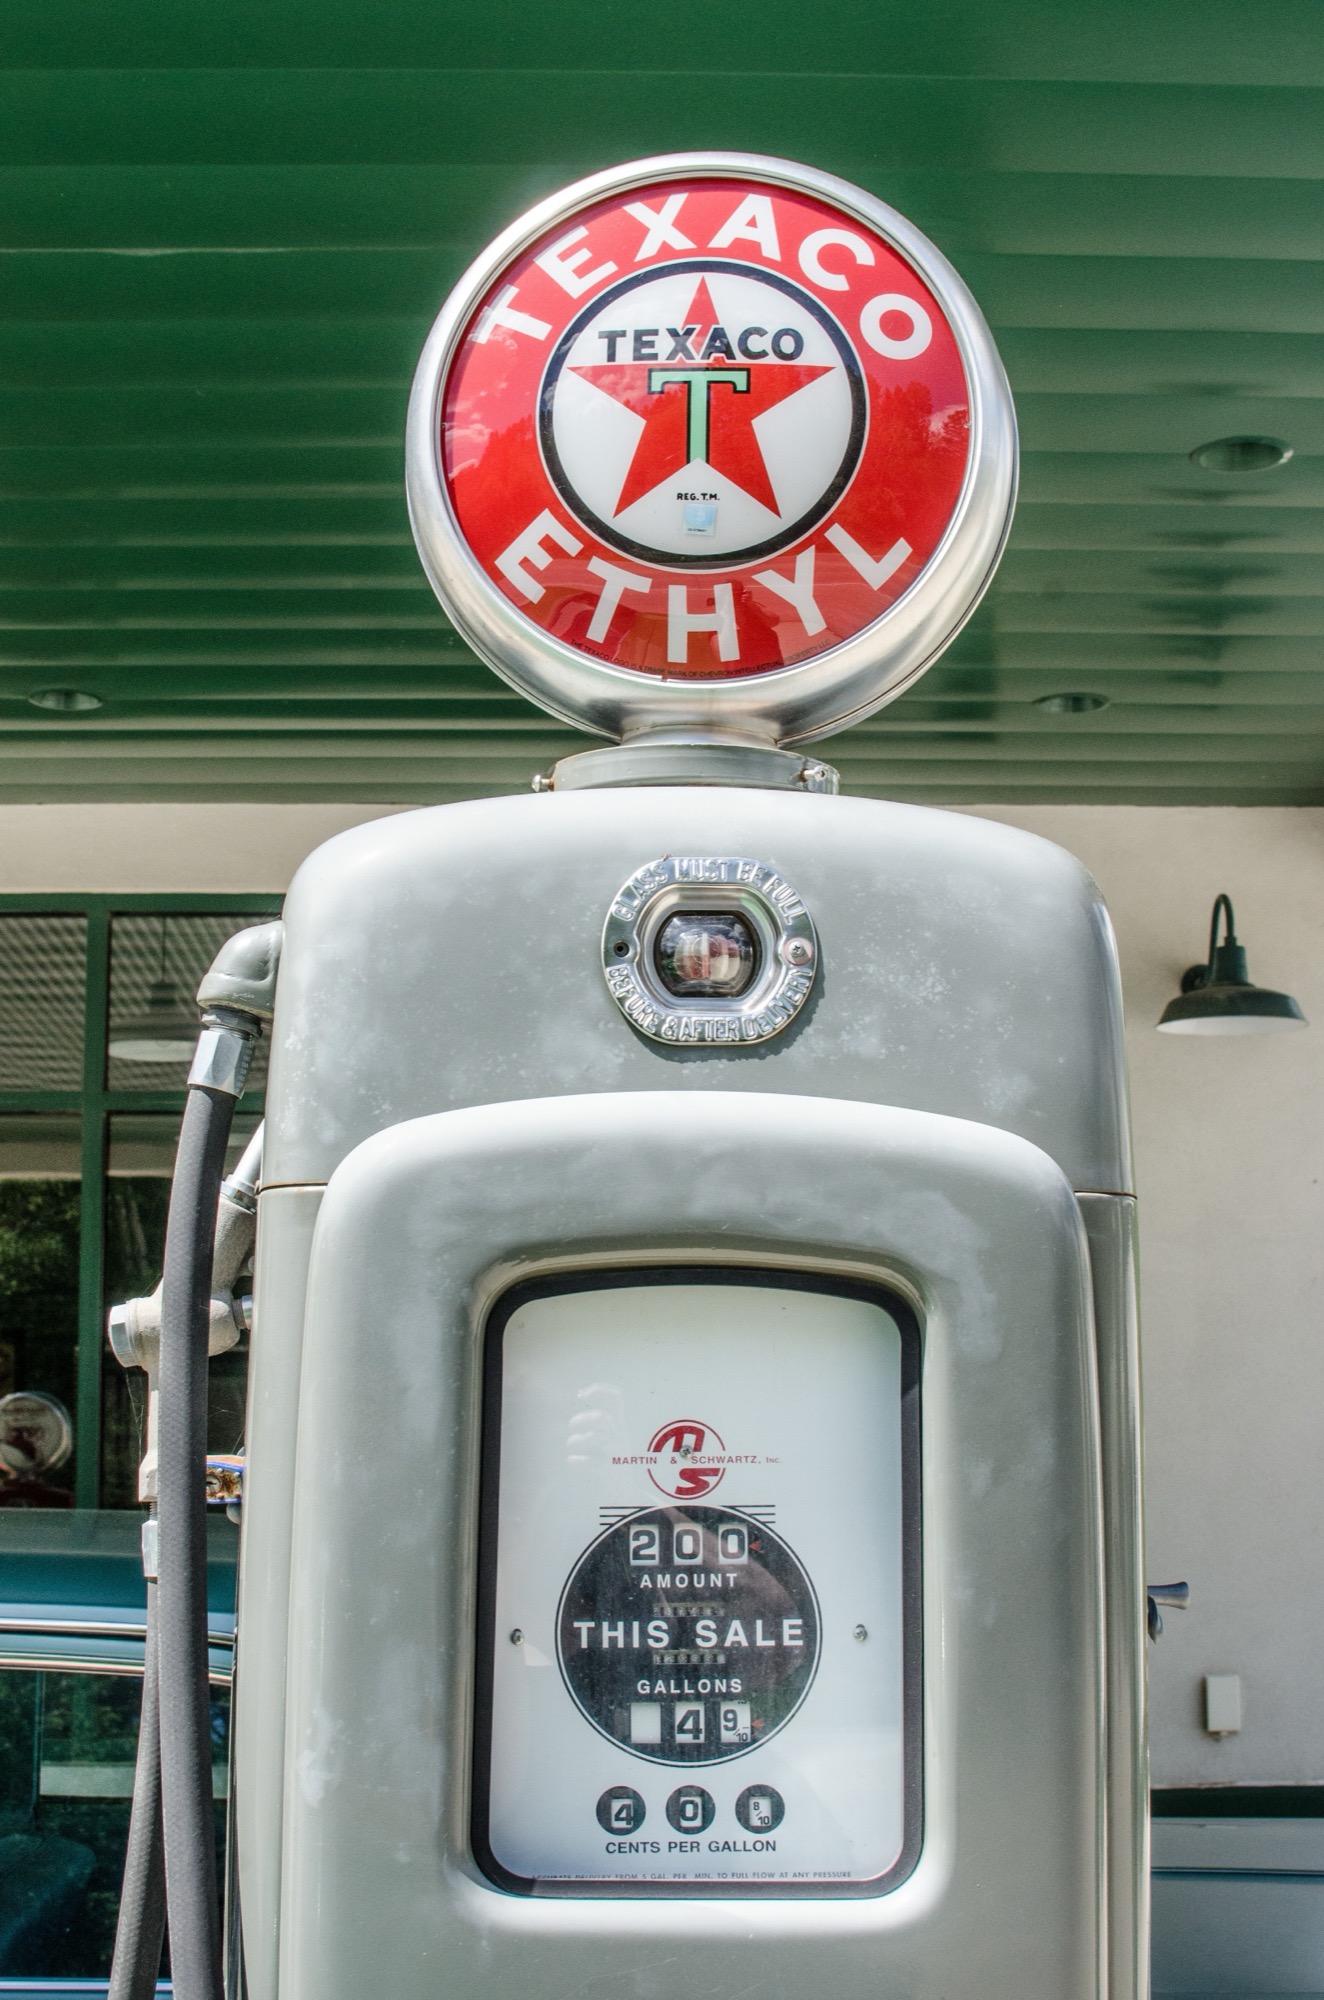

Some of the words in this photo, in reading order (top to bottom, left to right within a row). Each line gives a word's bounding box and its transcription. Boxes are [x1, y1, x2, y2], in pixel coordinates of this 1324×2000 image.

[475, 192, 933, 360] TEXACO
[598, 327, 804, 362] TEXACO
[648, 367, 750, 465] T
[676, 492, 699, 501] REG.
[494, 508, 913, 663] ETHYL
[569, 638, 583, 649] THE
[583, 645, 609, 660] TEXACO
[734, 658, 783, 674] INTELLECTUAL
[611, 863, 668, 921] GLASS
[672, 859, 730, 882] MUST
[737, 862, 767, 887] BE
[764, 874, 805, 925] FULL
[606, 965, 665, 1034] BEFORE
[661, 1016, 678, 1040] &
[679, 1017, 739, 1041] AFTER
[741, 968, 813, 1039] DELIVERY
[612, 1456, 657, 1465] MARTIN
[670, 1456, 677, 1465] &
[691, 1455, 761, 1464] SCHWARTZ,
[674, 1468, 721, 1495] S
[640, 1573, 738, 1589] AMOUNT
[573, 1621, 669, 1649] THIS
[695, 1619, 803, 1648] SALE
[637, 1678, 743, 1694] GALLONS
[605, 1842, 661, 1853] CENTS
[668, 1841, 700, 1853] PER
[708, 1840, 777, 1852] GALLON
